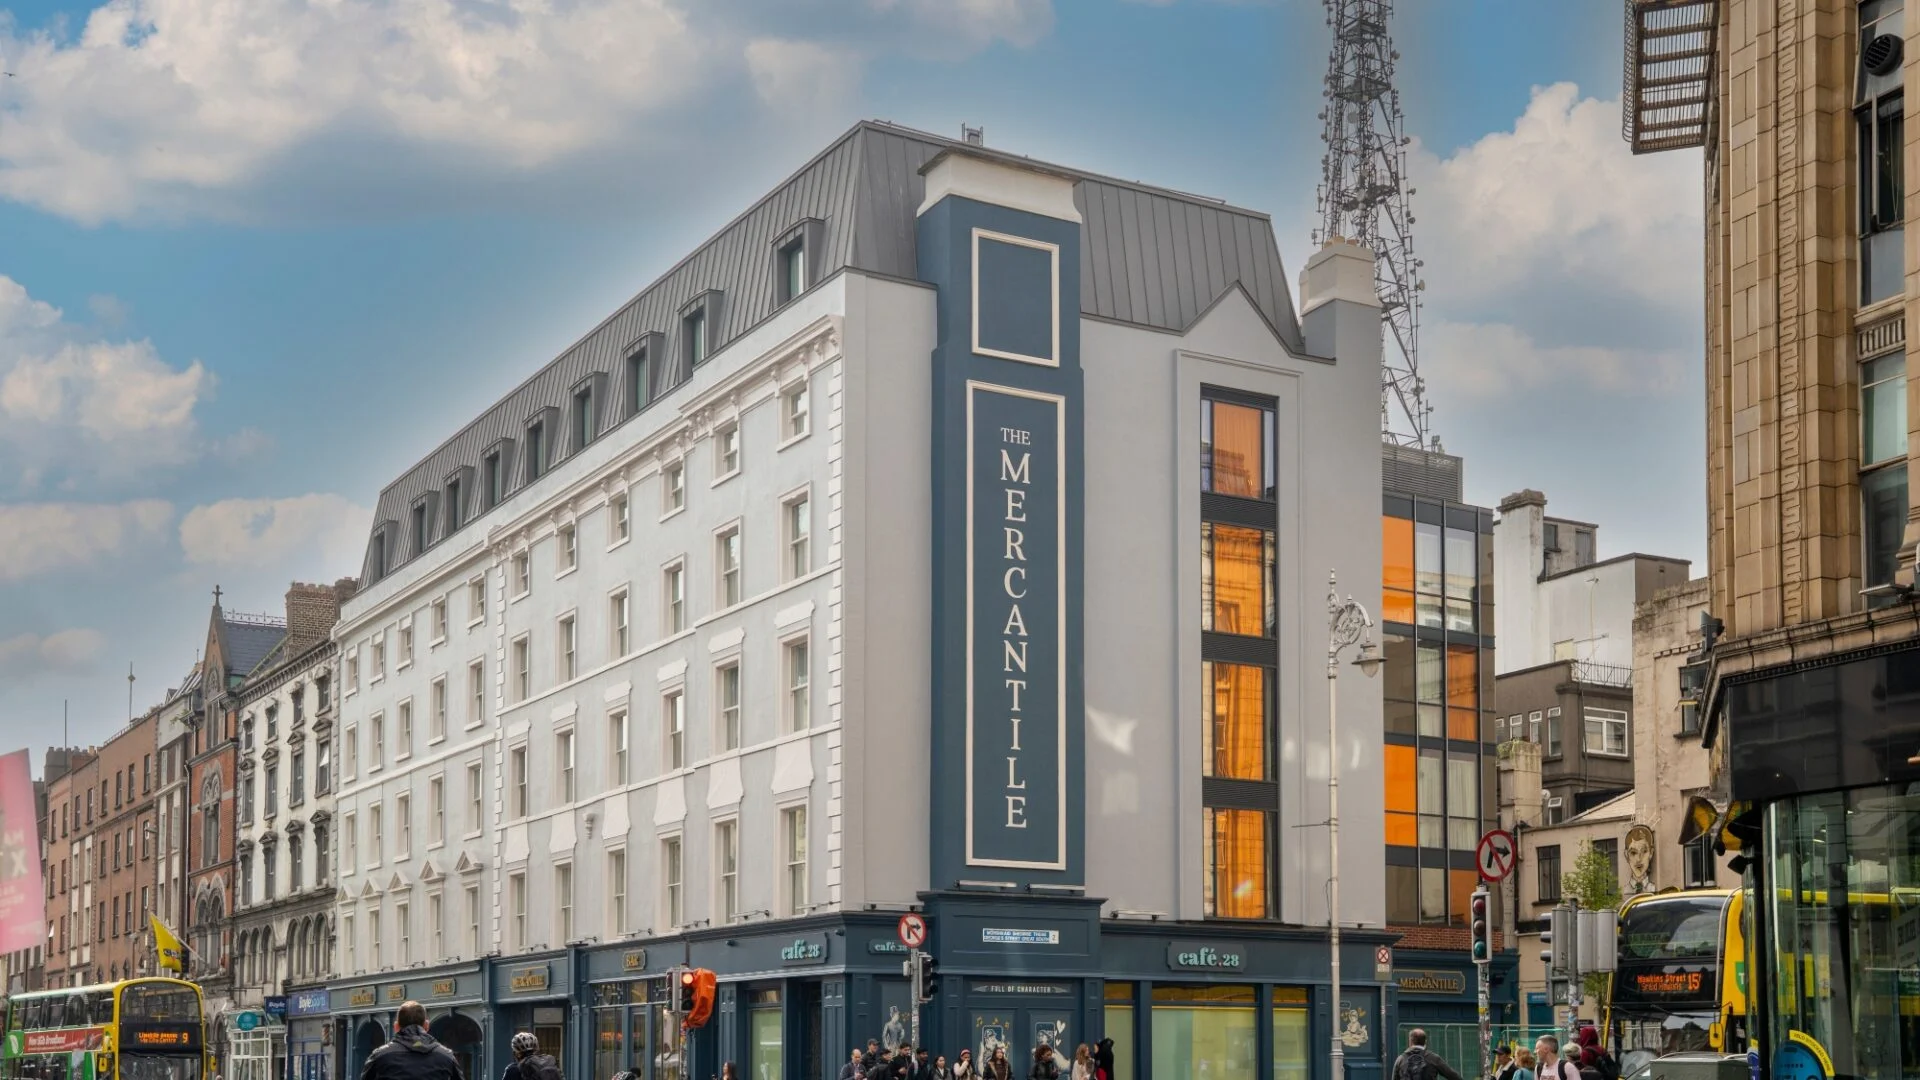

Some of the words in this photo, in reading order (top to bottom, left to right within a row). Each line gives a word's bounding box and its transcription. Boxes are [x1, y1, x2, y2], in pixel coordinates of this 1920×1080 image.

[1000, 427, 1031, 446] THE
[1000, 449, 1031, 829] MERCANTILE
[1178, 947, 1240, 967] café.28
[1400, 977, 1459, 990] MERCANTILE
[1665, 974, 1686, 983] Street
[991, 985, 1005, 993] FULL
[1007, 985, 1014, 993] OF
[1017, 986, 1051, 994] CHARACTER
[182, 1032, 189, 1044] 9
